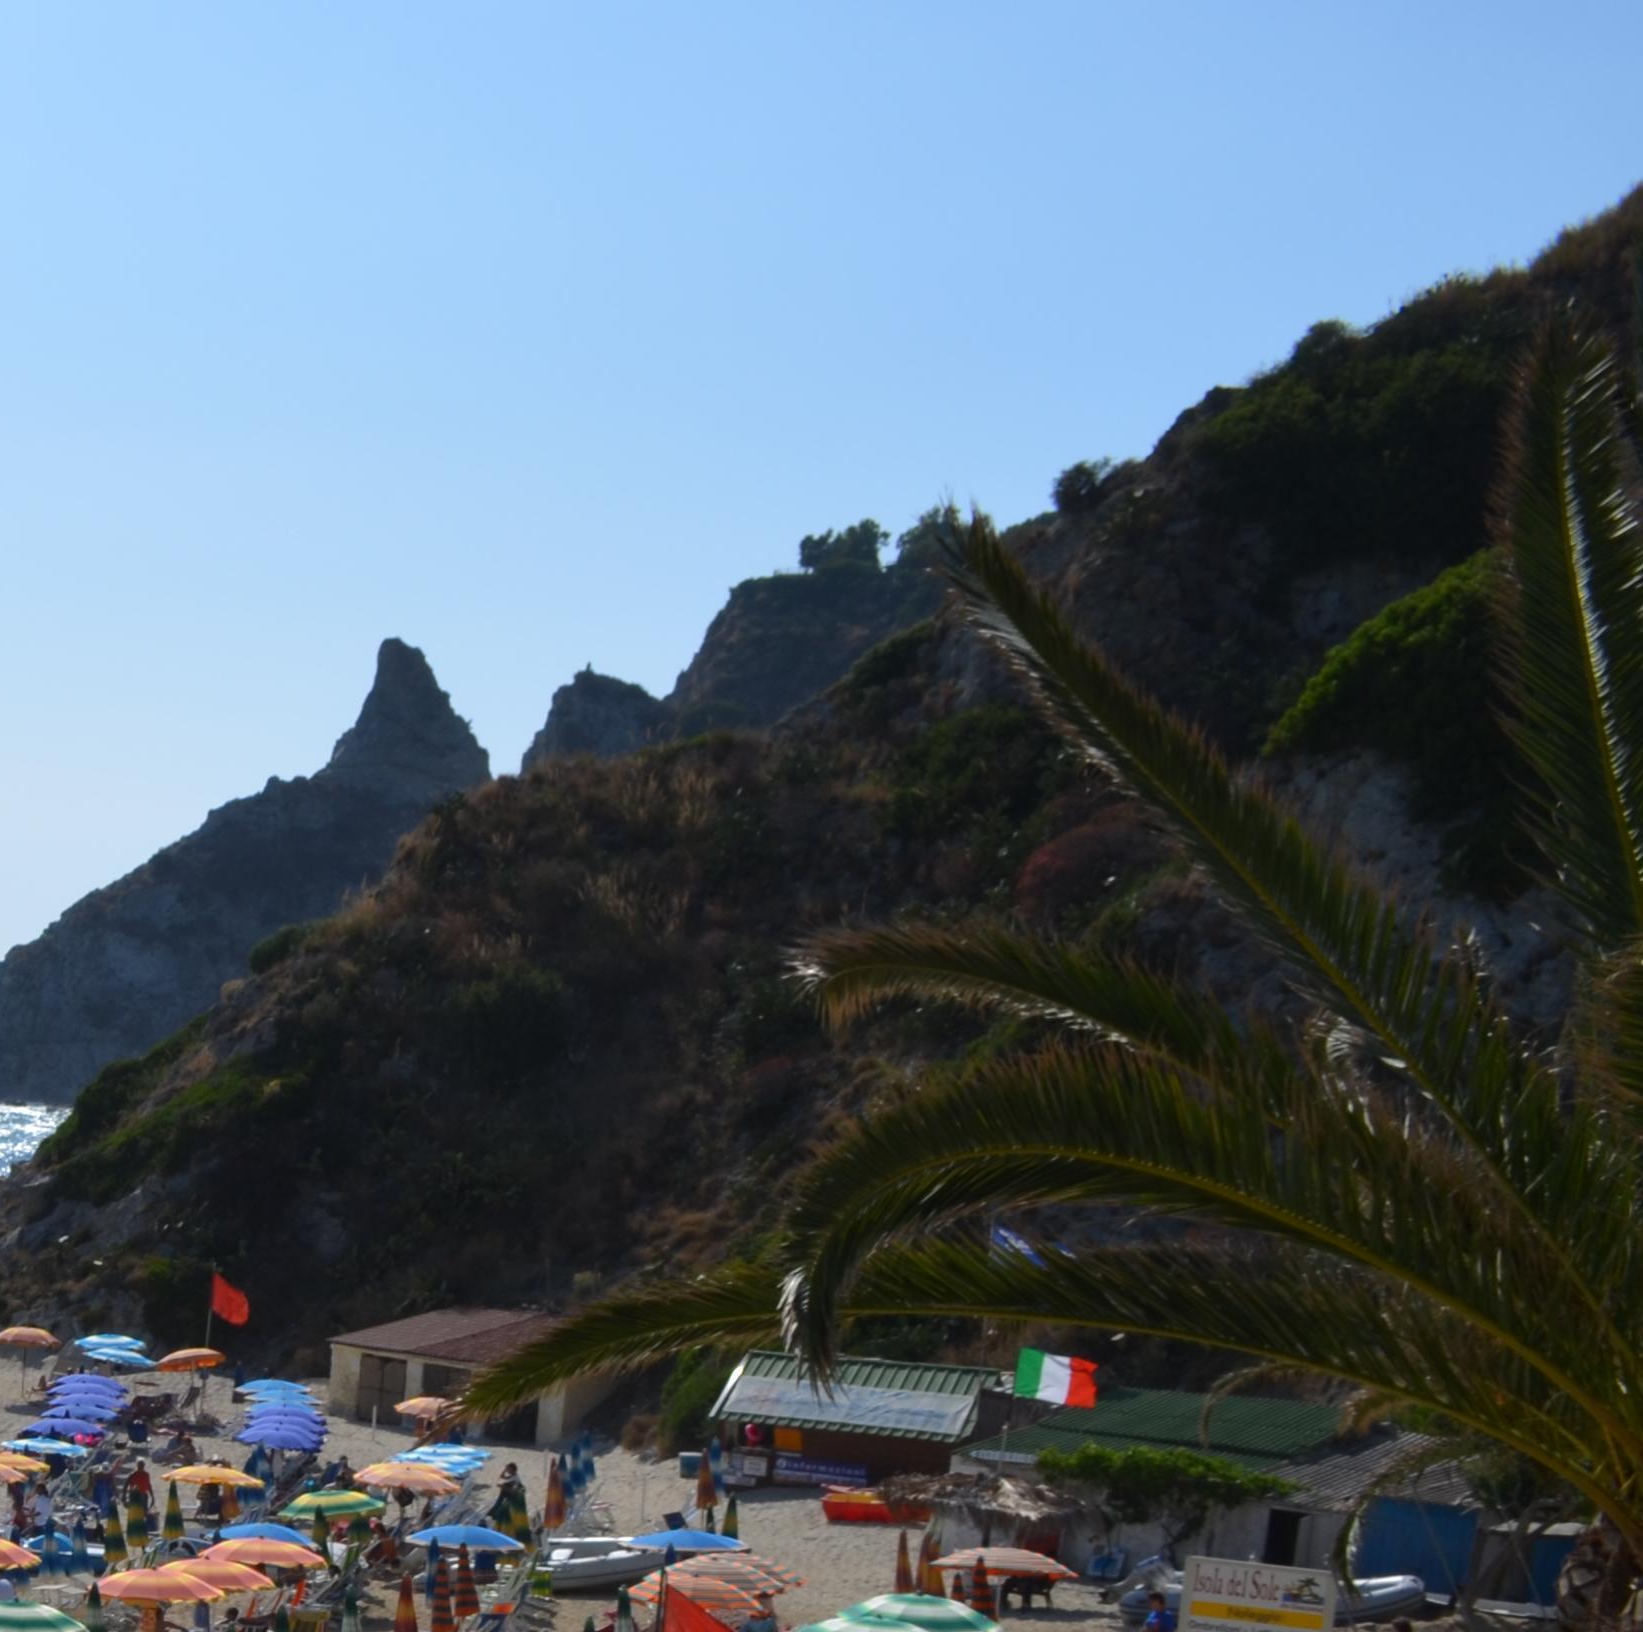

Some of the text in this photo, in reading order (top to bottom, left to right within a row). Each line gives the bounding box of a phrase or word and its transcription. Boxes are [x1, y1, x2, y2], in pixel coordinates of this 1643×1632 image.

[1193, 1564, 1279, 1601] Isola del Sole
